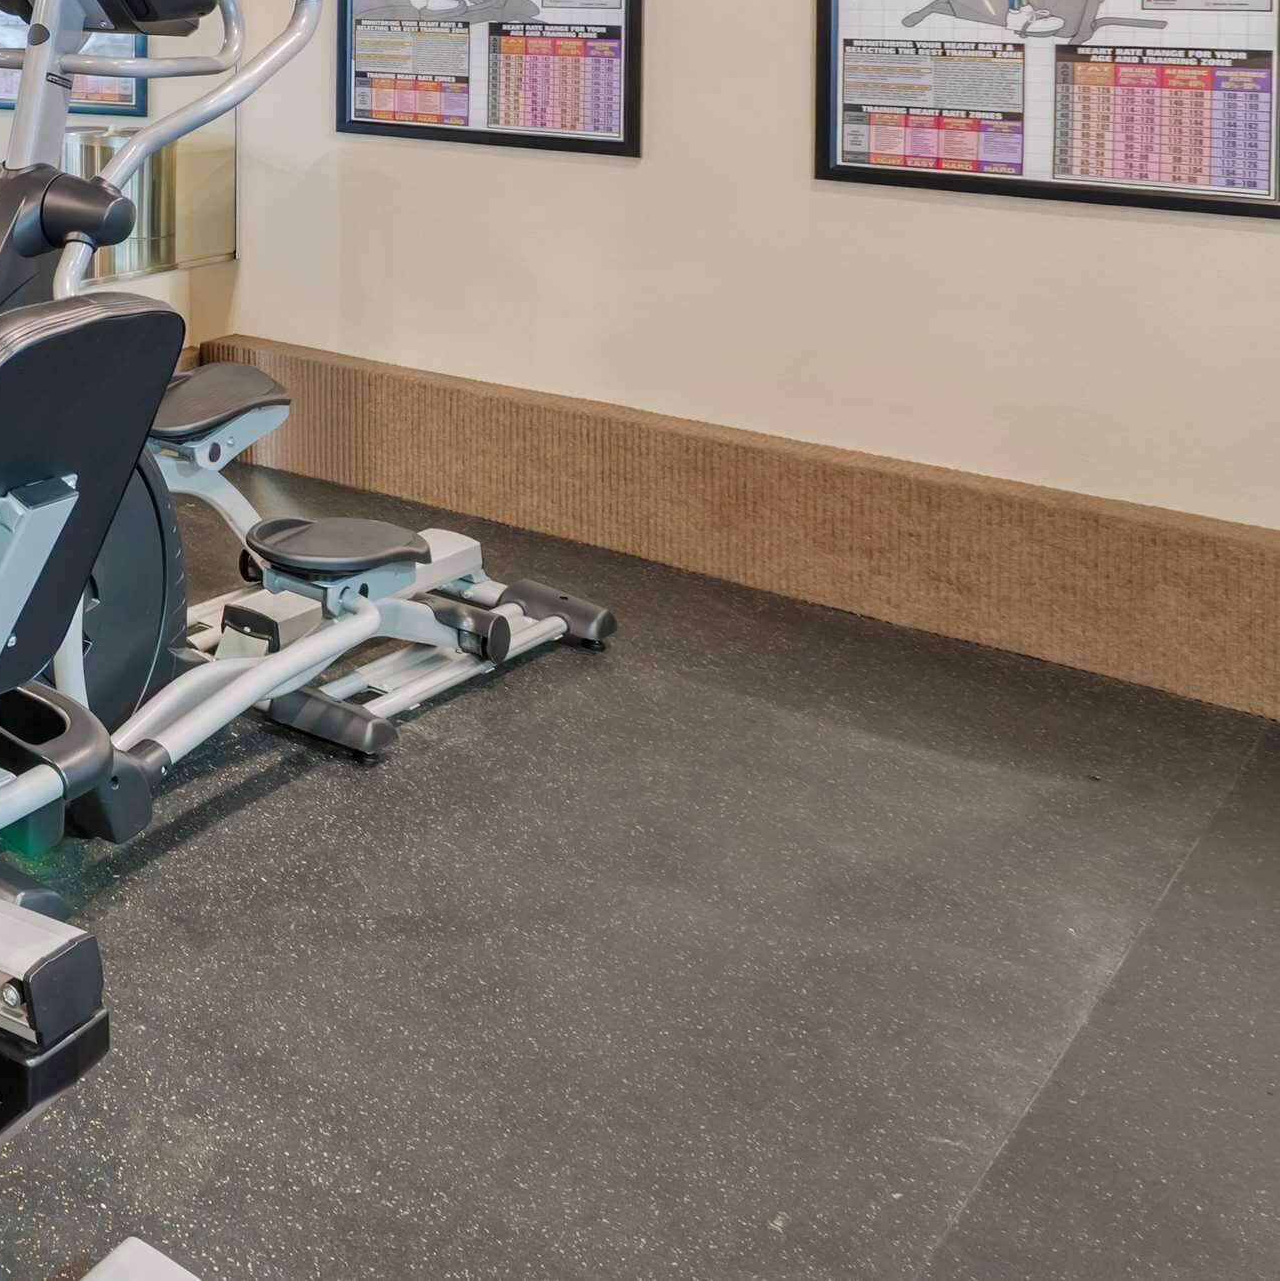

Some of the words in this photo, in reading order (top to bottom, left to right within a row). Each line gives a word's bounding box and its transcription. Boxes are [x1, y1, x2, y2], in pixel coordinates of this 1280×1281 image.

[845, 46, 897, 54] SELECTING
[898, 47, 917, 55] THE
[944, 42, 976, 50] HEART
[977, 43, 1003, 51] RATE
[1077, 47, 1113, 56] HEART
[1115, 48, 1143, 56] RATE
[1145, 49, 1185, 58] RANGE
[1188, 50, 1213, 59] FOR
[1215, 51, 1248, 60] YOUR
[1090, 55, 1113, 63] AGE
[1114, 55, 1139, 63] AND
[1141, 56, 1198, 65] TRAINING
[1200, 58, 1233, 67] ZONE
